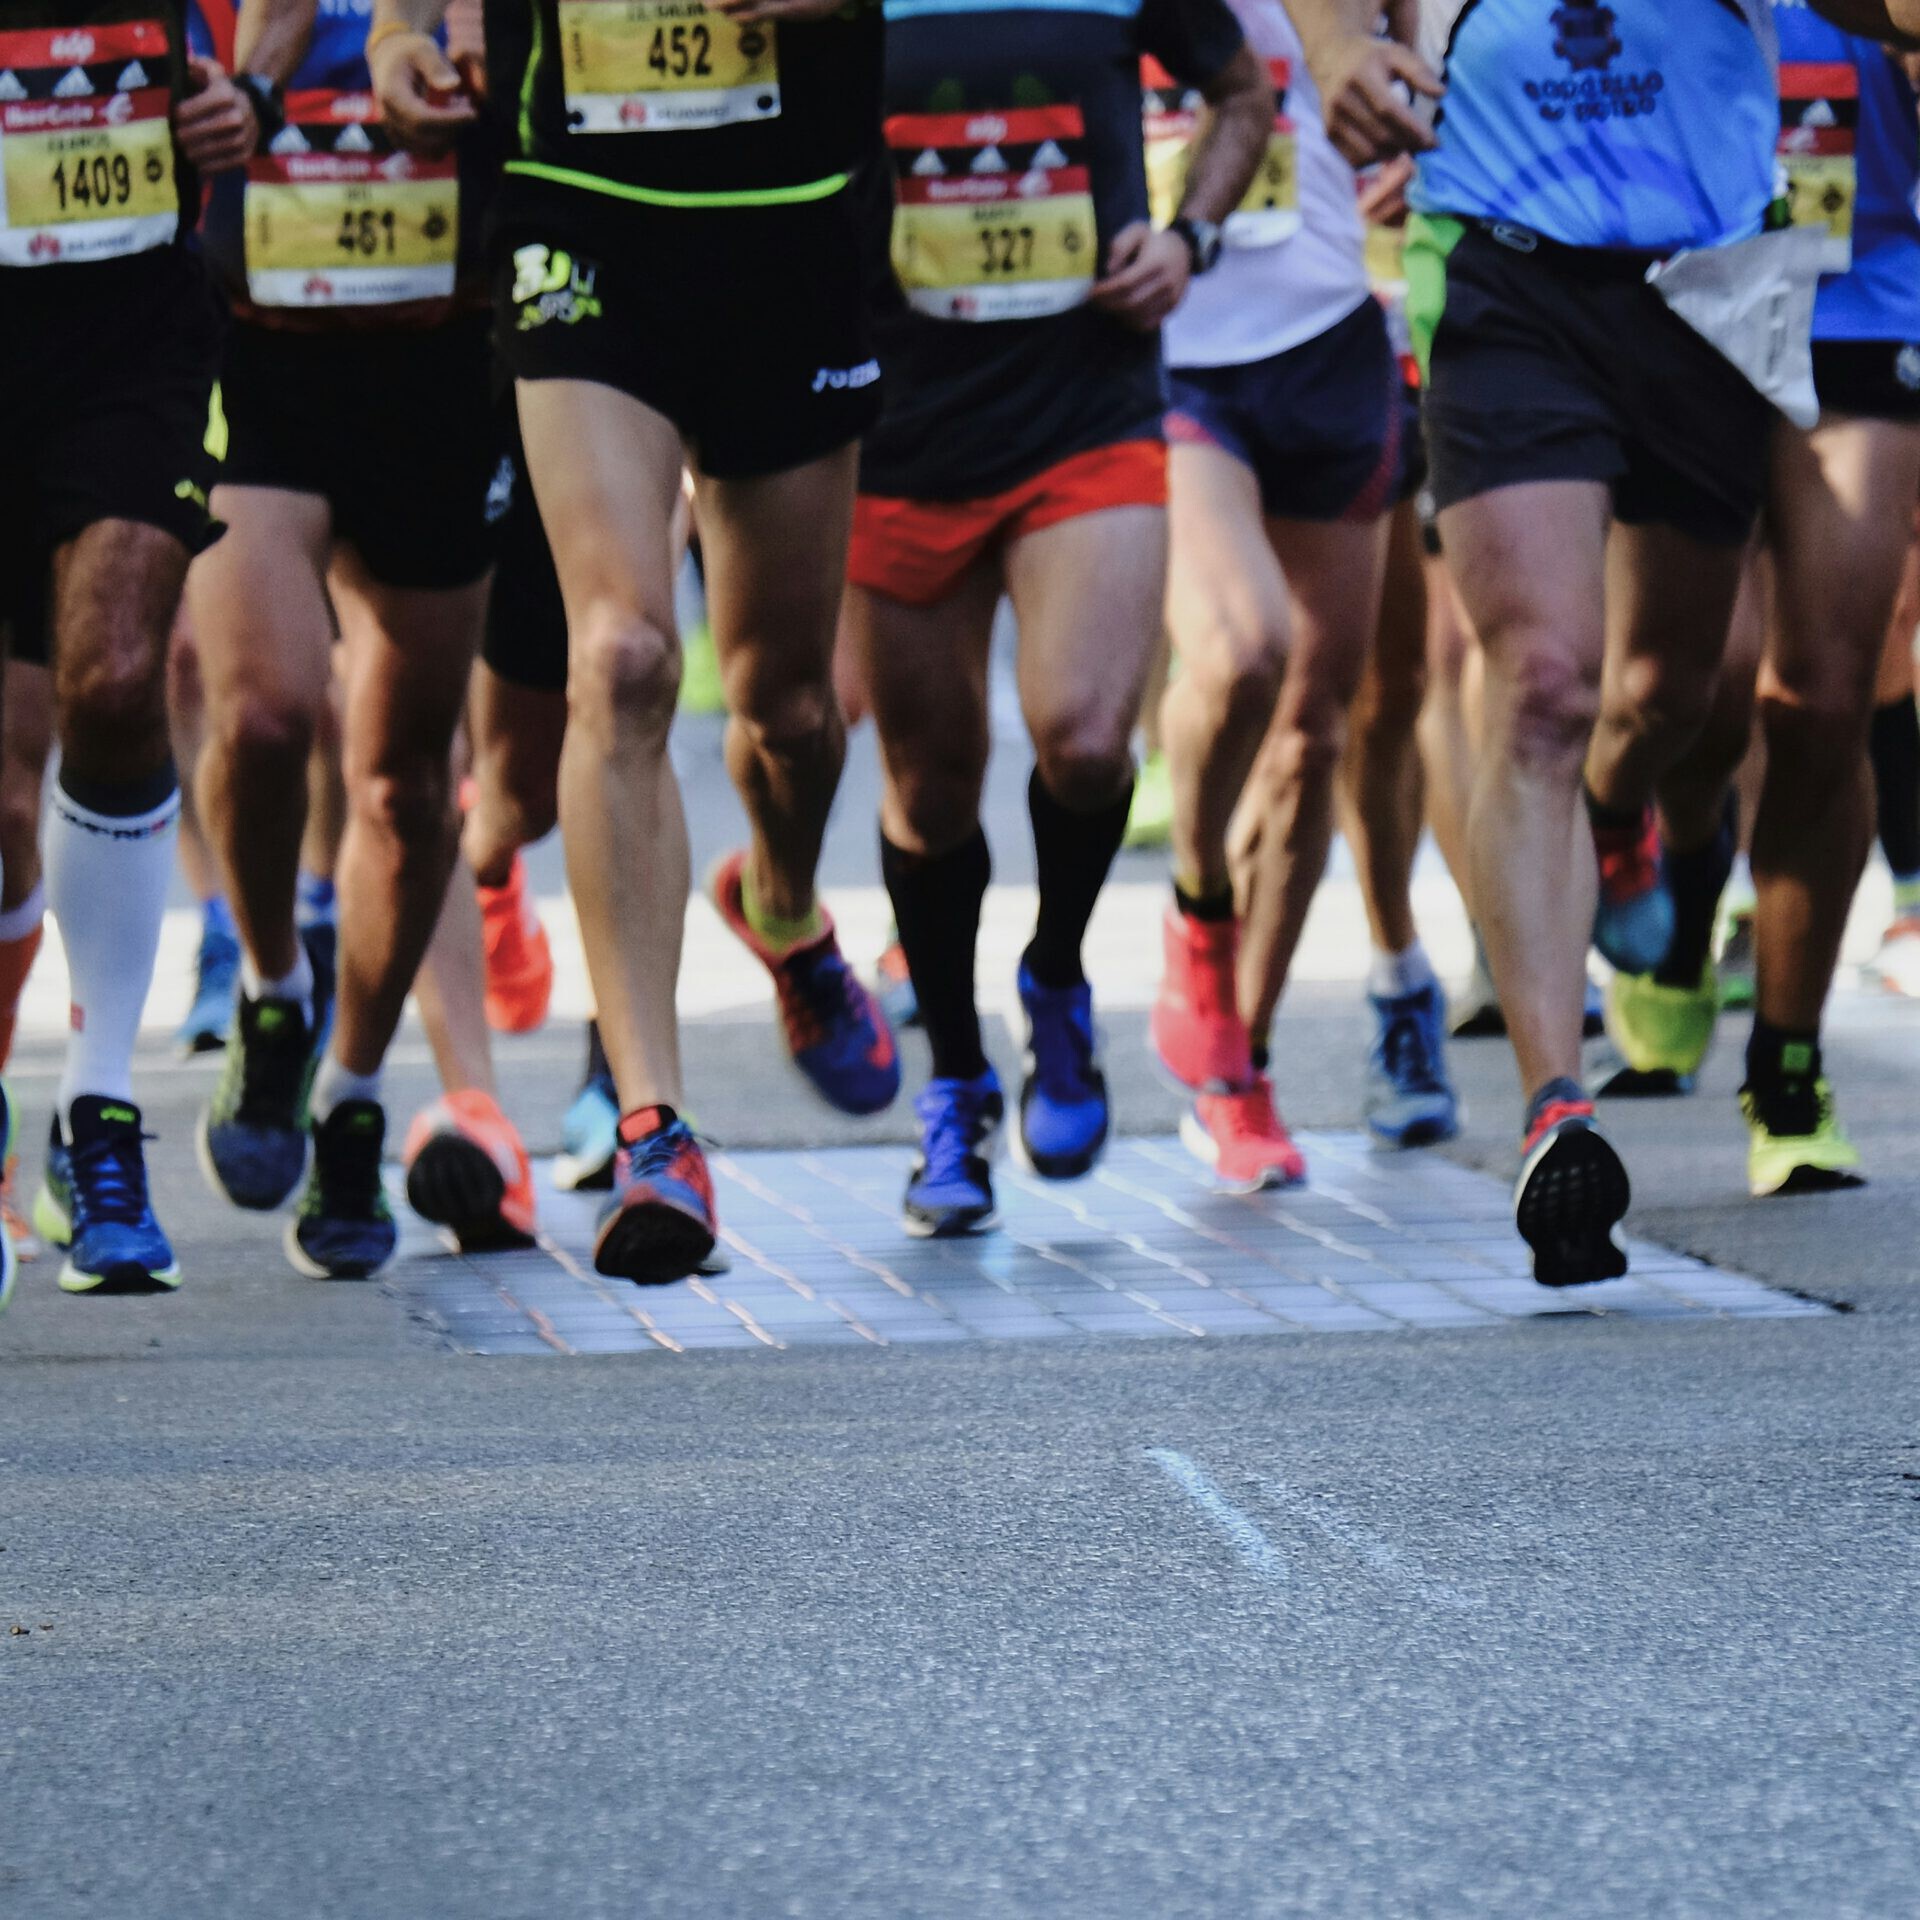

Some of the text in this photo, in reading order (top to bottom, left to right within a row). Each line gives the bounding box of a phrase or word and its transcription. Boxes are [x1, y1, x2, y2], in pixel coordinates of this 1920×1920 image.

[648, 24, 713, 76] 452
[53, 154, 131, 211] 1409
[337, 209, 395, 256] 461
